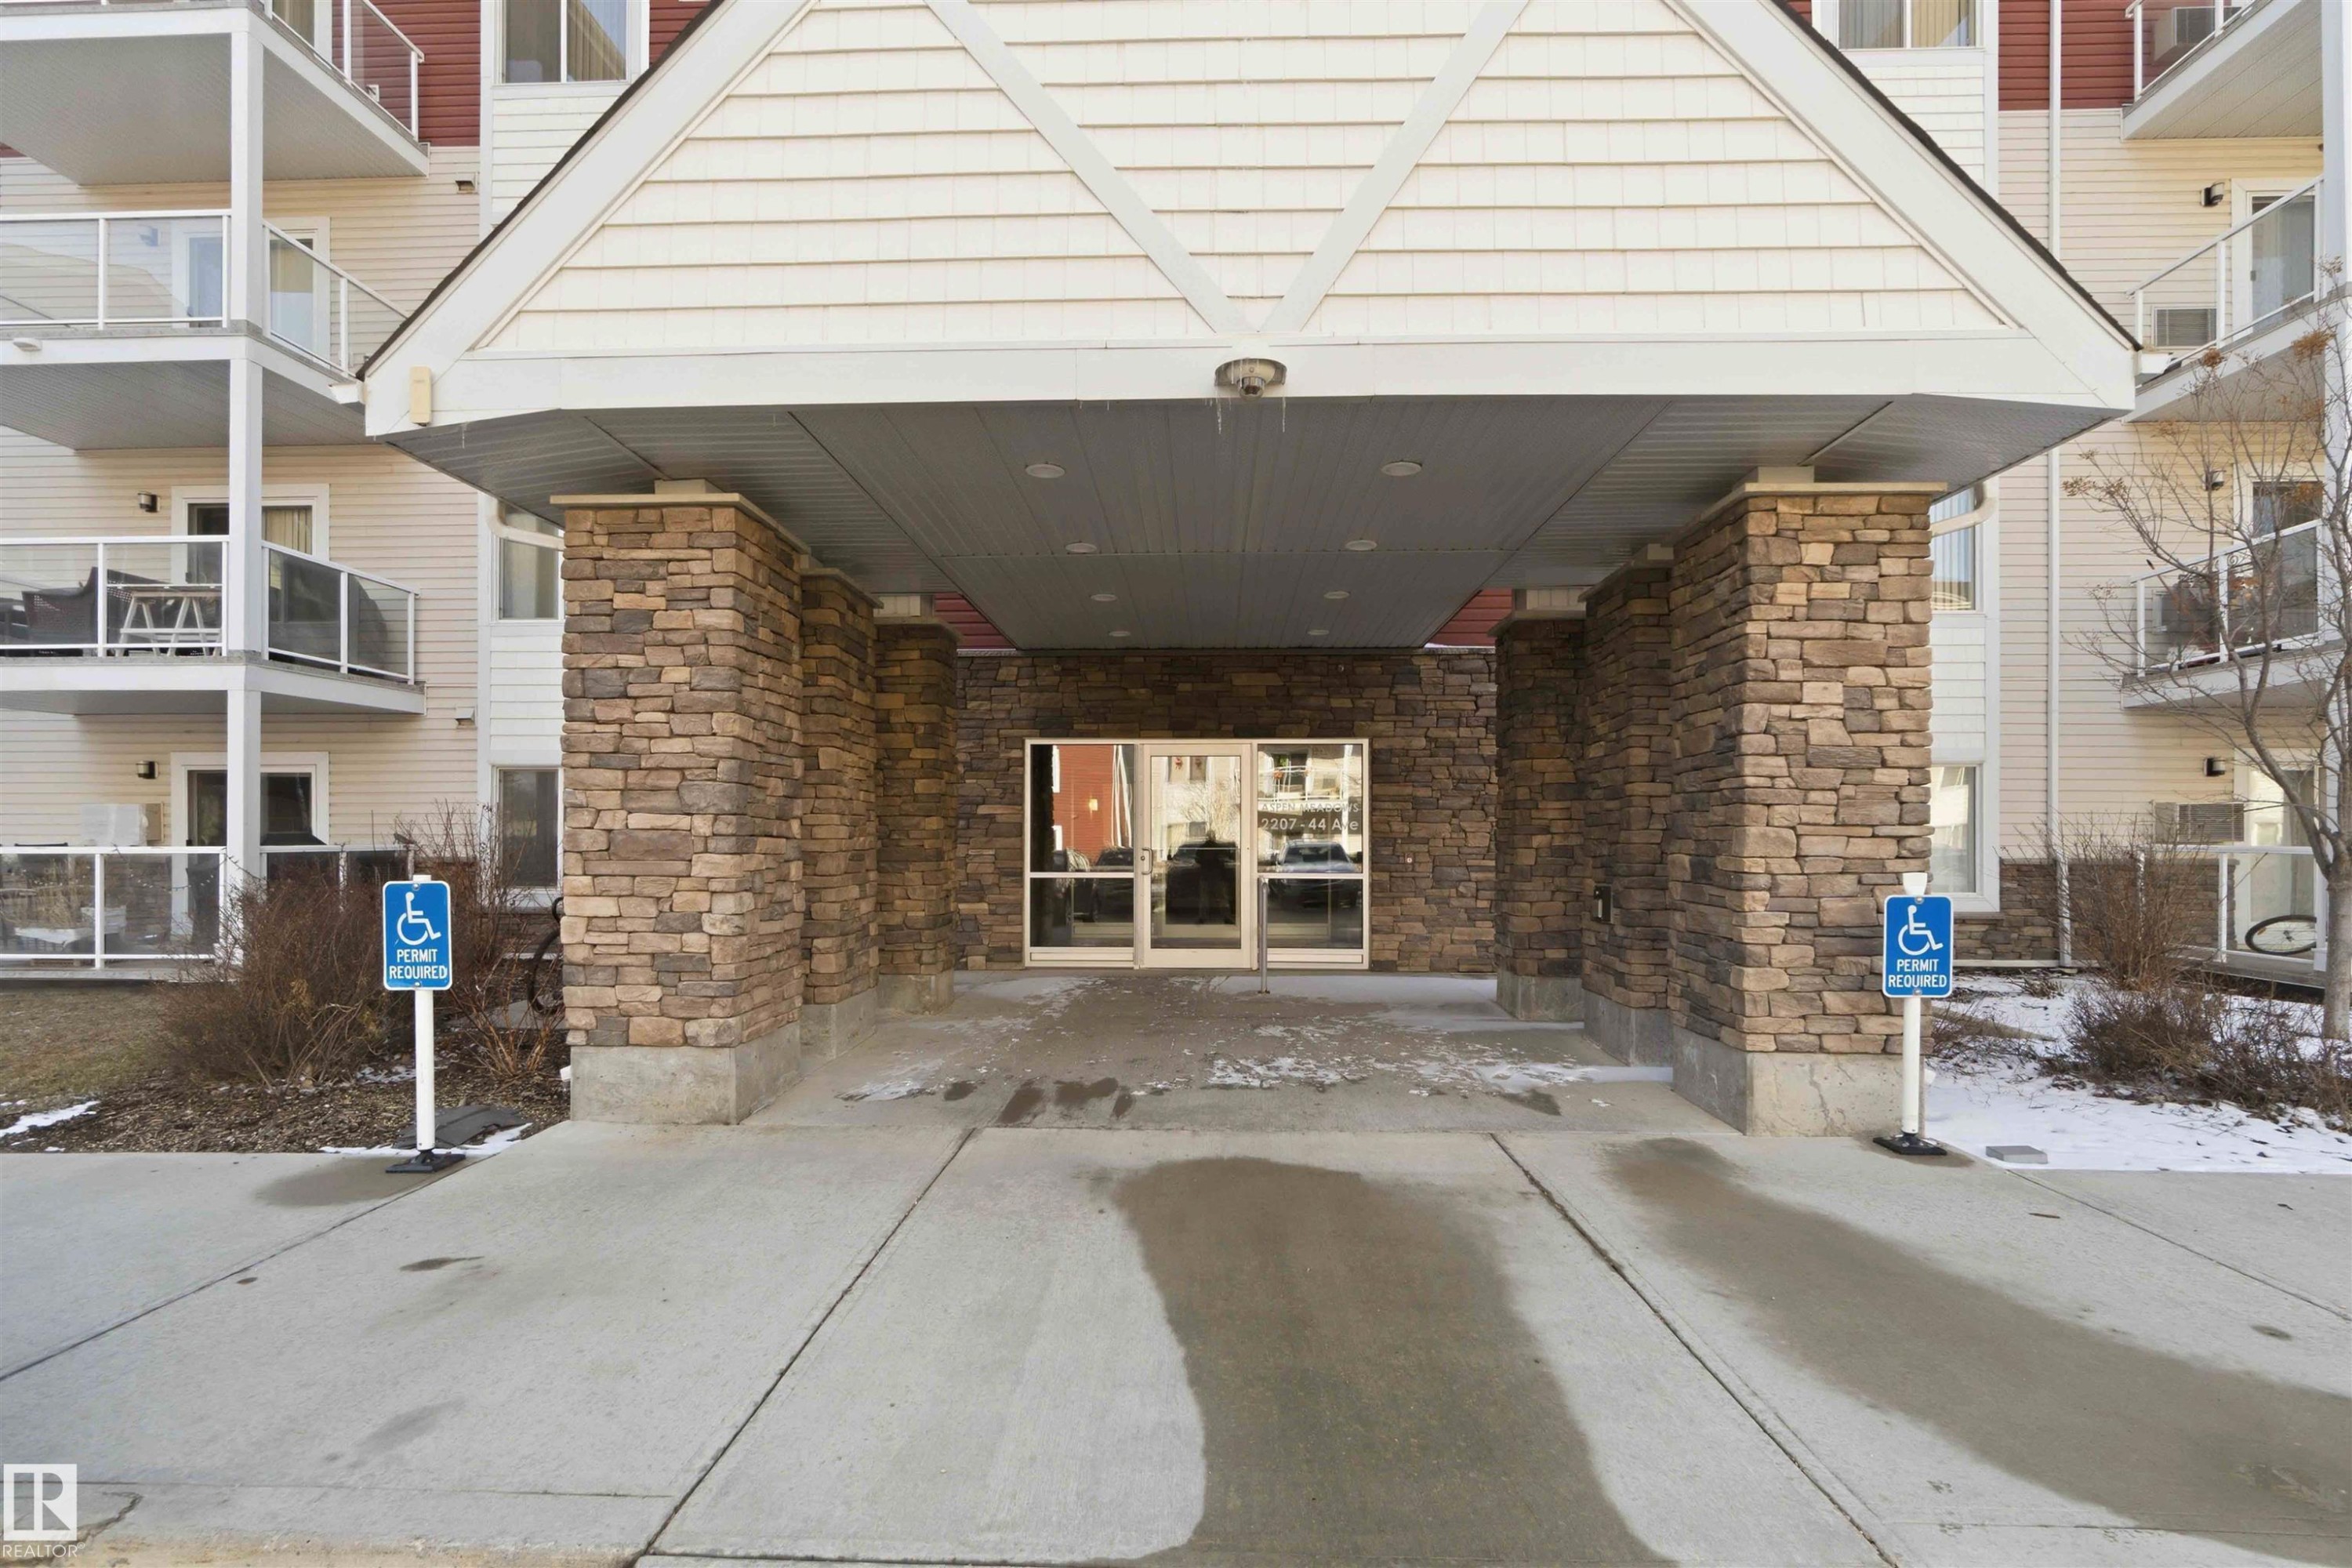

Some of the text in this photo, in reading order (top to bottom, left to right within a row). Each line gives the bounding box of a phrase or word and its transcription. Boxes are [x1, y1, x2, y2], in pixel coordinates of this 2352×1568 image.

[1261, 803, 1359, 813] ASPEN MEADOWS
[1261, 818, 1298, 830] 2207
[1308, 818, 1327, 830] 44
[1331, 818, 1359, 831] Ave
[397, 949, 438, 964] PERMIT
[1896, 959, 1940, 972] PERMIT
[389, 965, 448, 980] REQUIRED
[1888, 975, 1947, 989] REQUIRED
